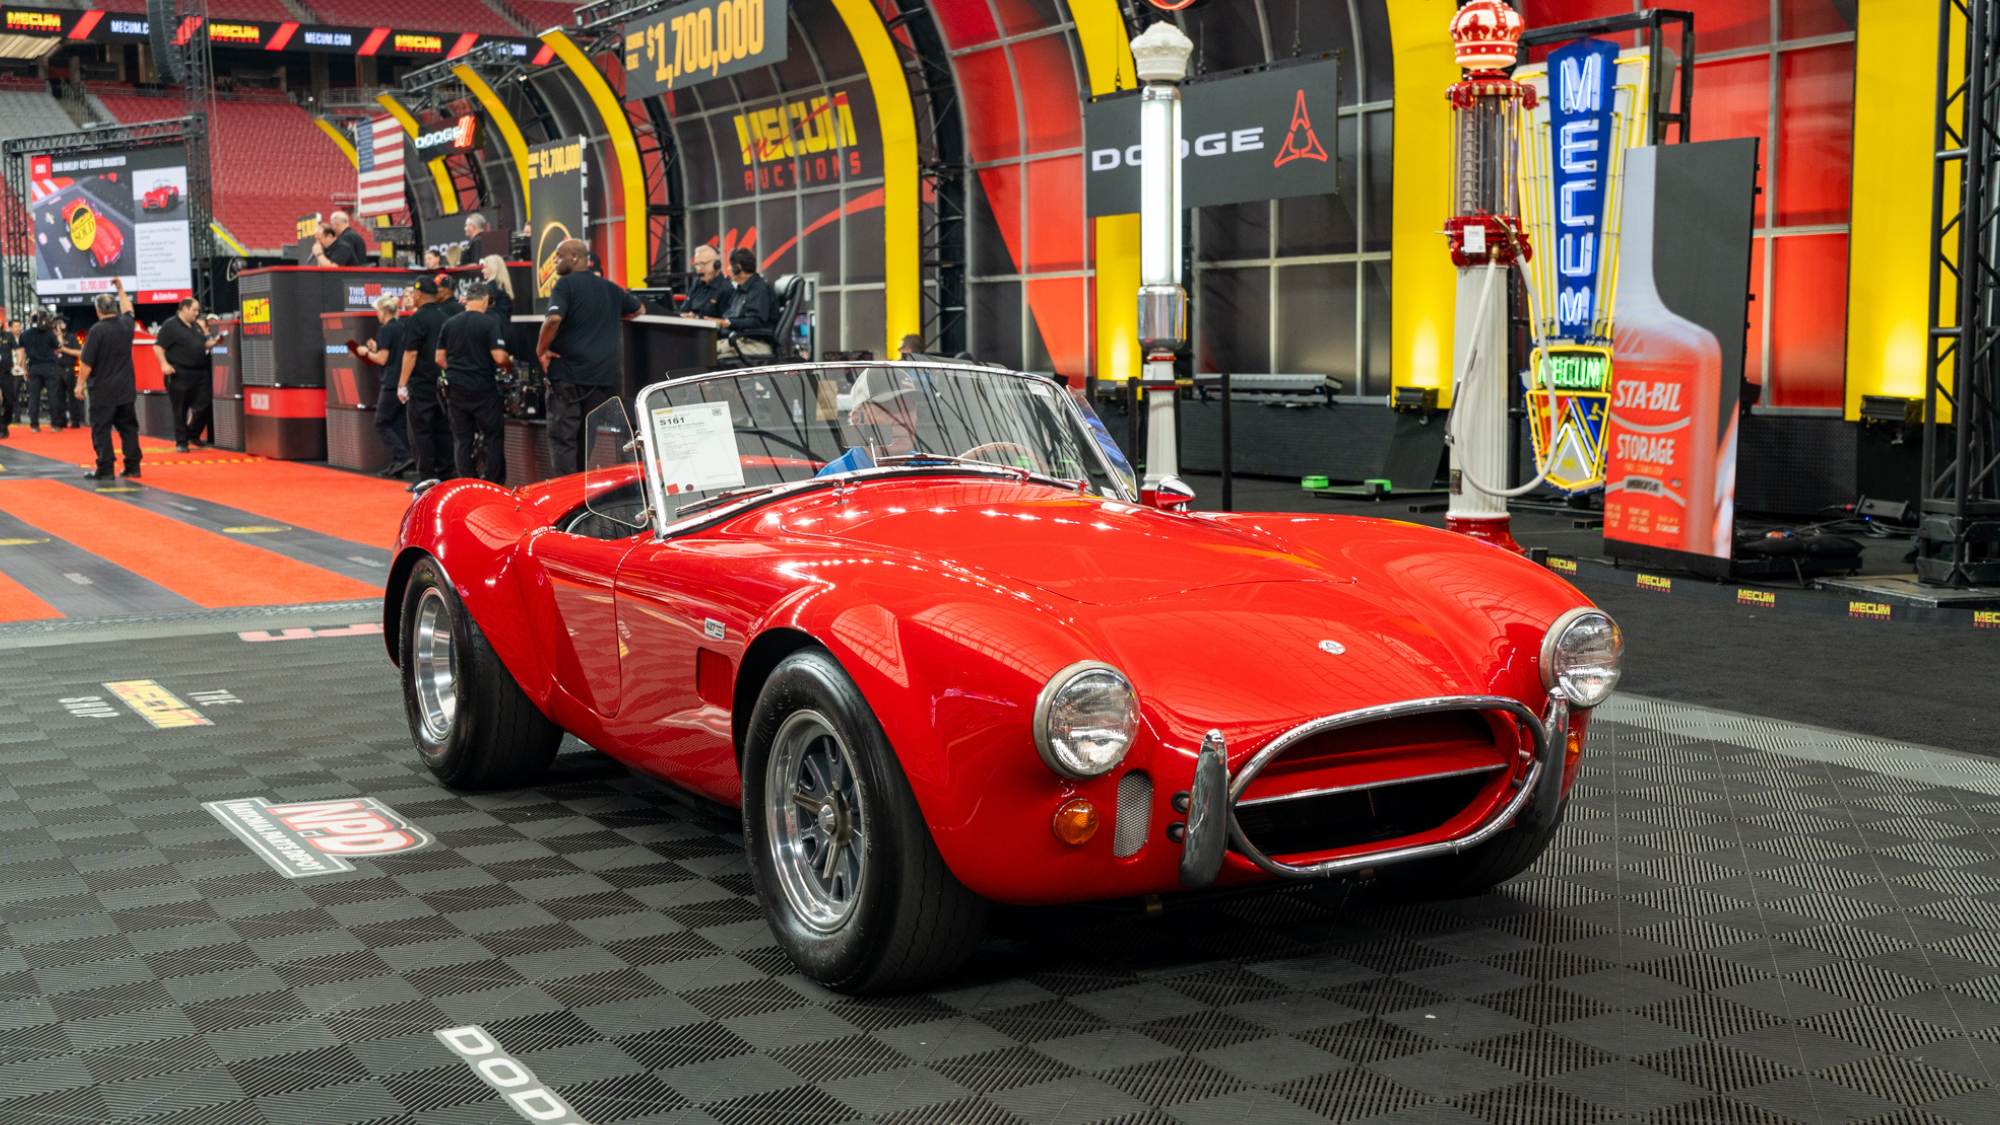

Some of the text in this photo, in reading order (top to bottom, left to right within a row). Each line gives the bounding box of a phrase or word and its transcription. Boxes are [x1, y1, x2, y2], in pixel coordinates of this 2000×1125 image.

[7, 12, 61, 26] MECUM
[209, 24, 260, 38] MECUM
[304, 32, 352, 46] MECUM.COM
[395, 34, 442, 49] MECUM
[647, 0, 764, 89] $1,700,000
[734, 91, 857, 165] MECUM
[415, 126, 462, 149] DODGE
[1092, 127, 1264, 171] DOGE
[540, 143, 581, 178] $1,700,000
[1560, 52, 1605, 325] MECUM
[80, 280, 108, 292] $1,700,000
[348, 286, 365, 296] THIS
[659, 416, 685, 426] S161
[1617, 433, 1674, 465] STORAGE
[1546, 556, 1577, 572] MECUM
[1636, 583, 1671, 593] AUCTIONS
[1637, 573, 1671, 588] MECUM
[1737, 589, 1775, 603] MECUM
[1737, 598, 1775, 608] AUCTIONS
[1849, 601, 1891, 615] MECUM
[1849, 611, 1891, 620] AUCTIONS
[104, 679, 208, 728] MECUM
[186, 689, 244, 706] THE
[58, 696, 120, 718] SHOP
[268, 801, 414, 853] NPD
[224, 802, 327, 869] NATIONAL PARTS DEPOT
[440, 1027, 588, 1125] DOD
